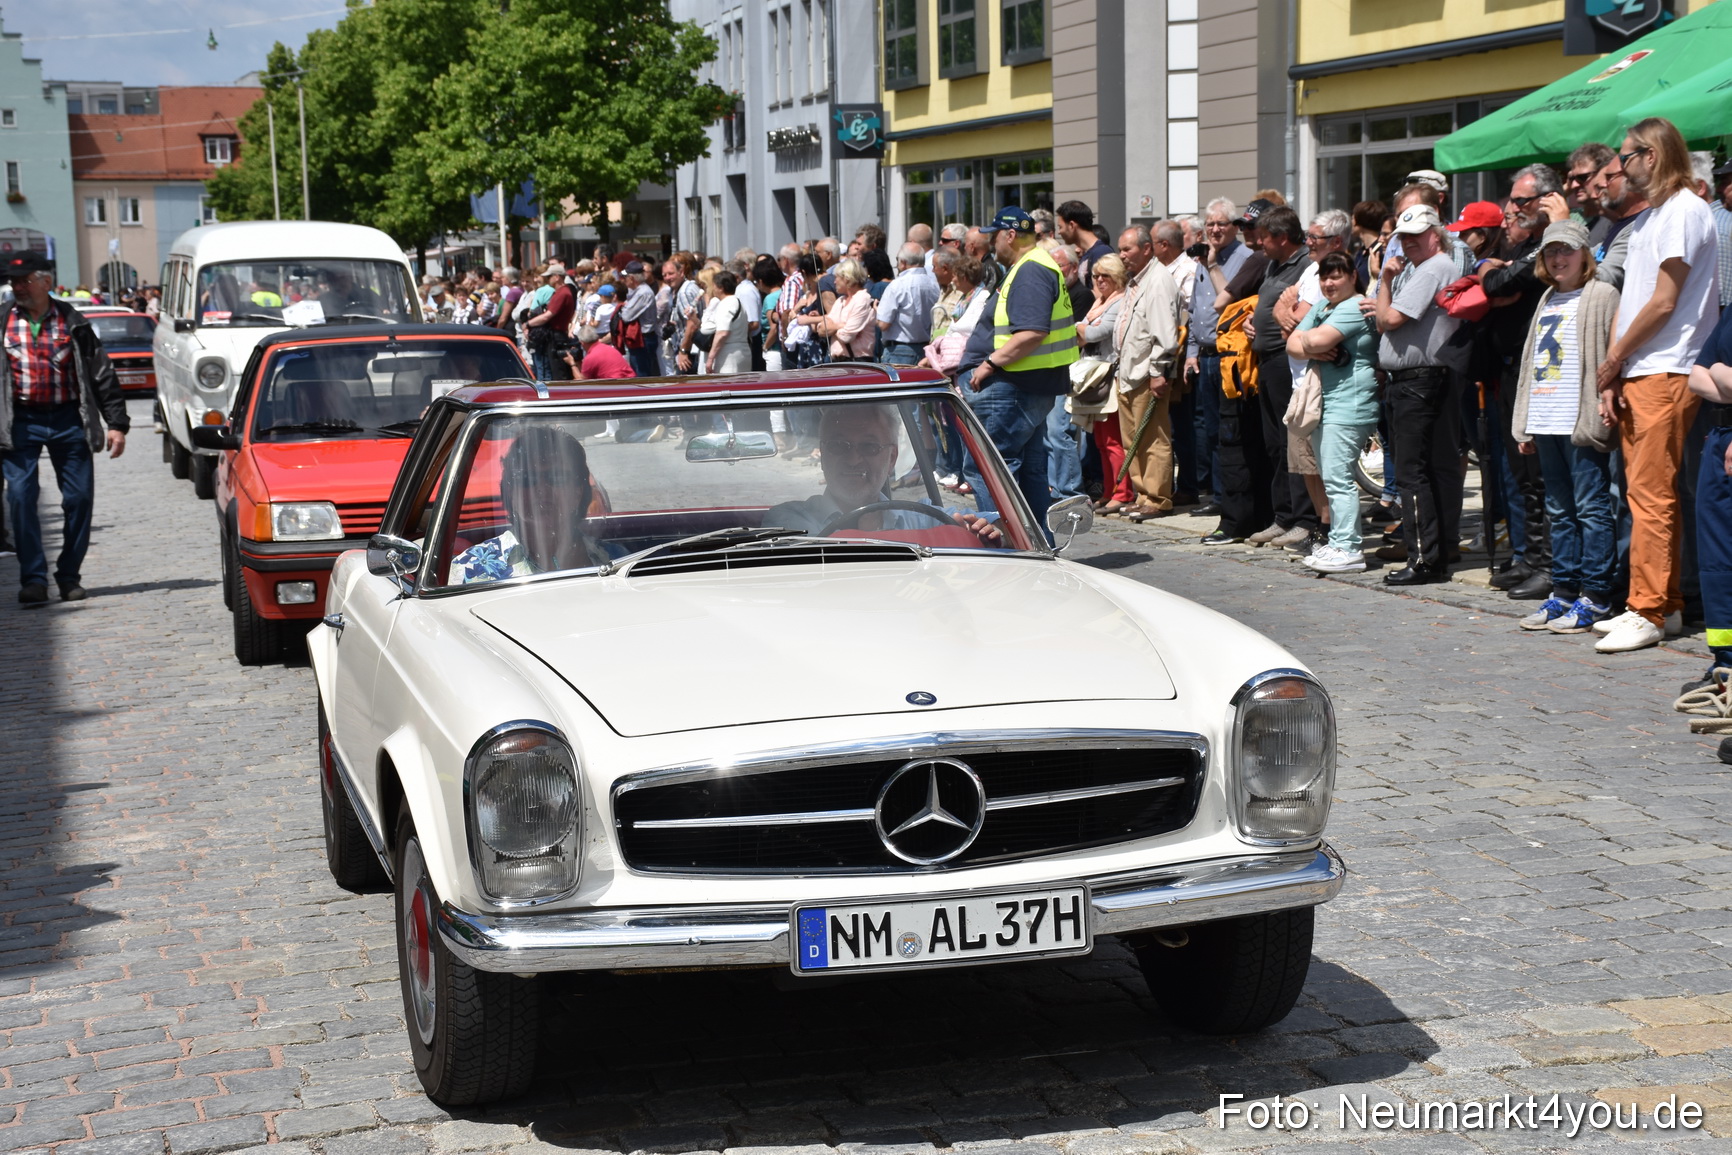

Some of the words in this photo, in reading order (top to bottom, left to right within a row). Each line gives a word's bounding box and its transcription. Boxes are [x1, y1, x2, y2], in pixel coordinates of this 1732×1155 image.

[850, 118, 868, 141] G2
[1534, 314, 1564, 382] 3
[830, 911, 893, 960] NM
[928, 905, 987, 953] AL
[995, 895, 1081, 946] 37H
[809, 944, 820, 958] D
